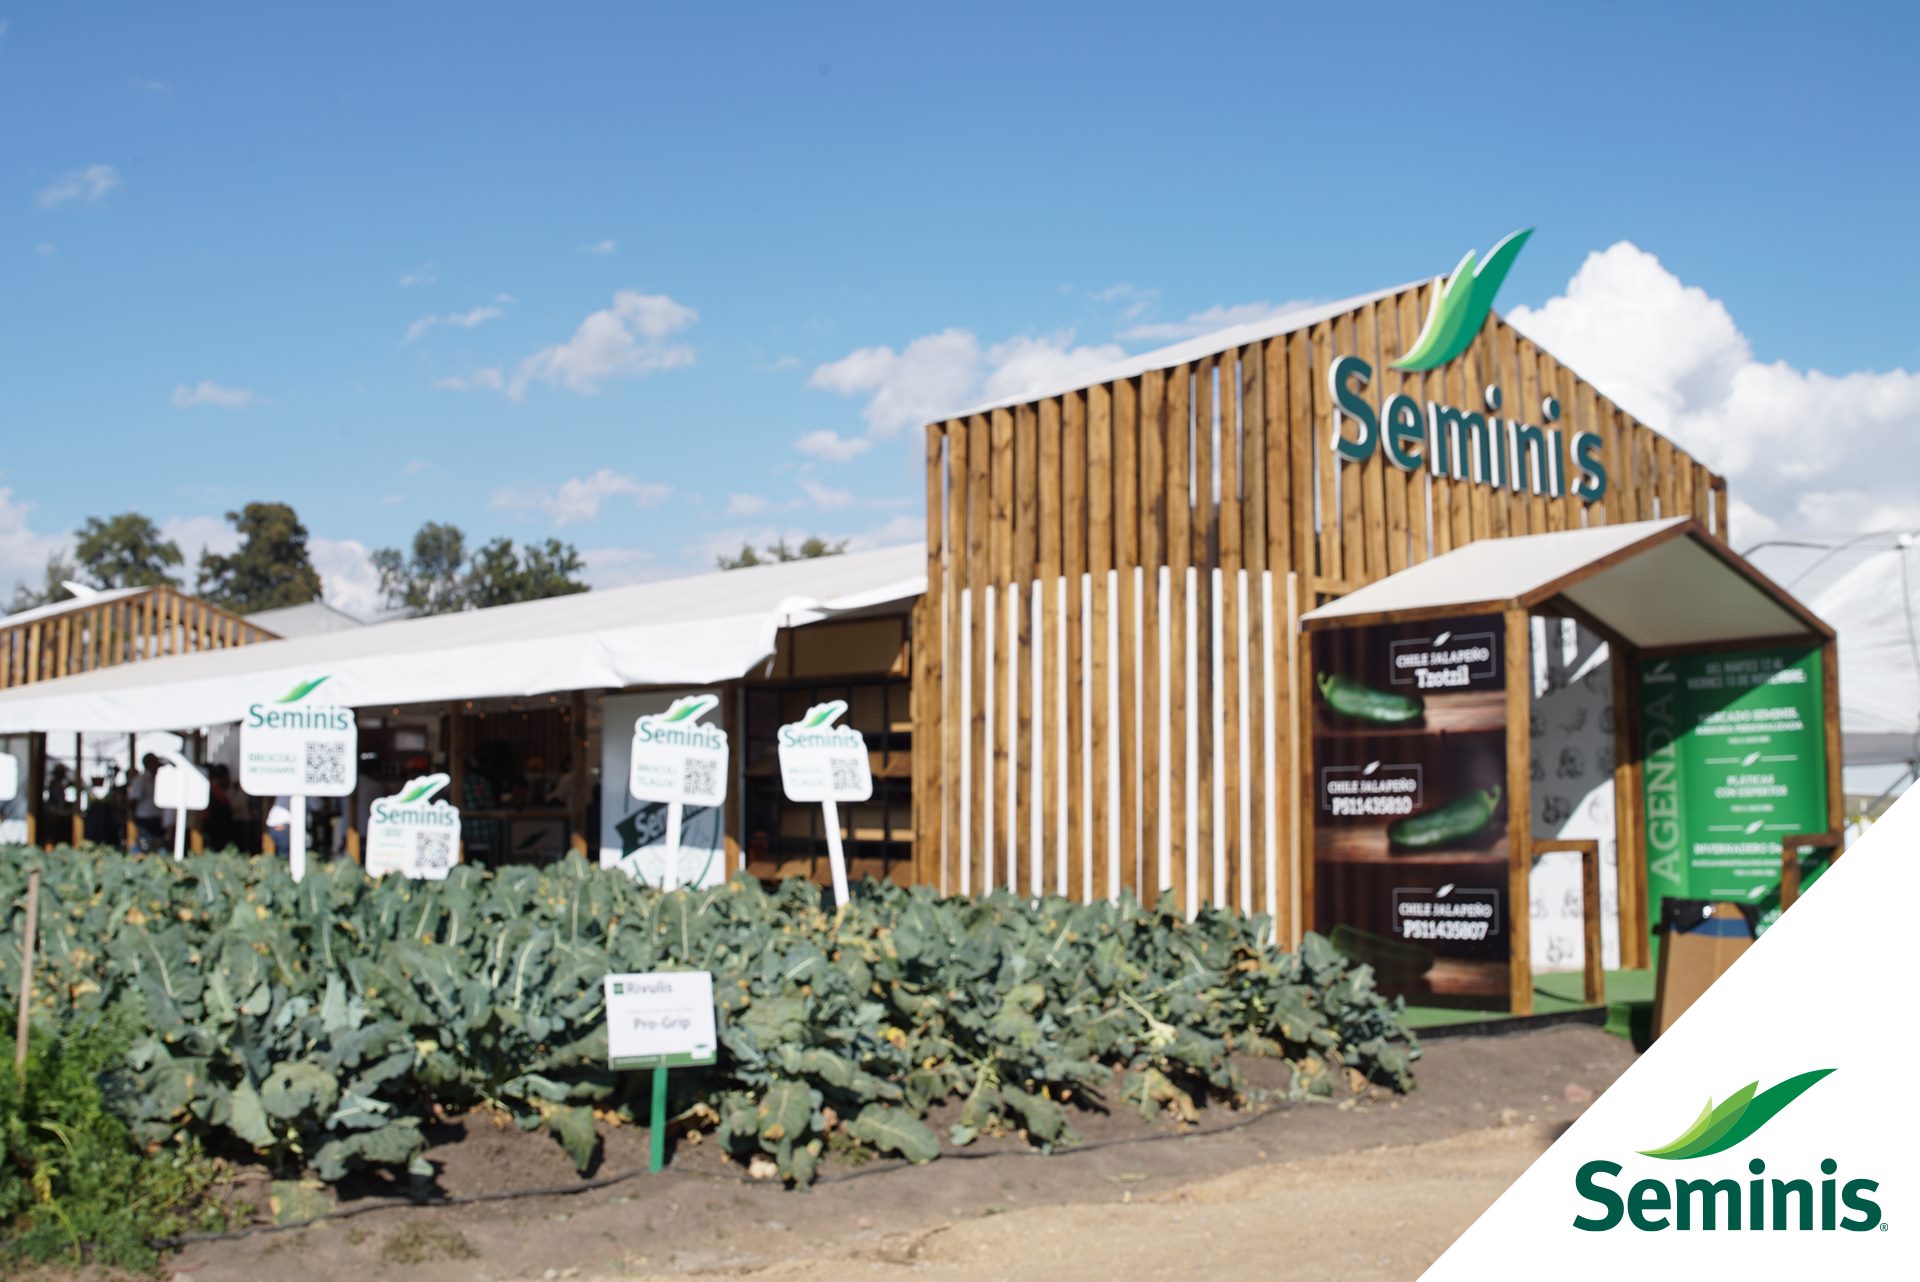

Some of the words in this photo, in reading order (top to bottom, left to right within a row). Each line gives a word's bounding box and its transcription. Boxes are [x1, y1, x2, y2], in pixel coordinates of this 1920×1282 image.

[1328, 354, 1607, 502] Seminis
[1414, 664, 1470, 688] Tzotzil
[248, 703, 349, 731] Seminis
[639, 720, 722, 751] Seminis
[783, 727, 860, 749] Seminis
[1645, 692, 1681, 885] AGENDA
[375, 802, 454, 827] Seminis
[626, 981, 673, 994] Rivulis
[633, 1015, 692, 1031] Pro-Grip
